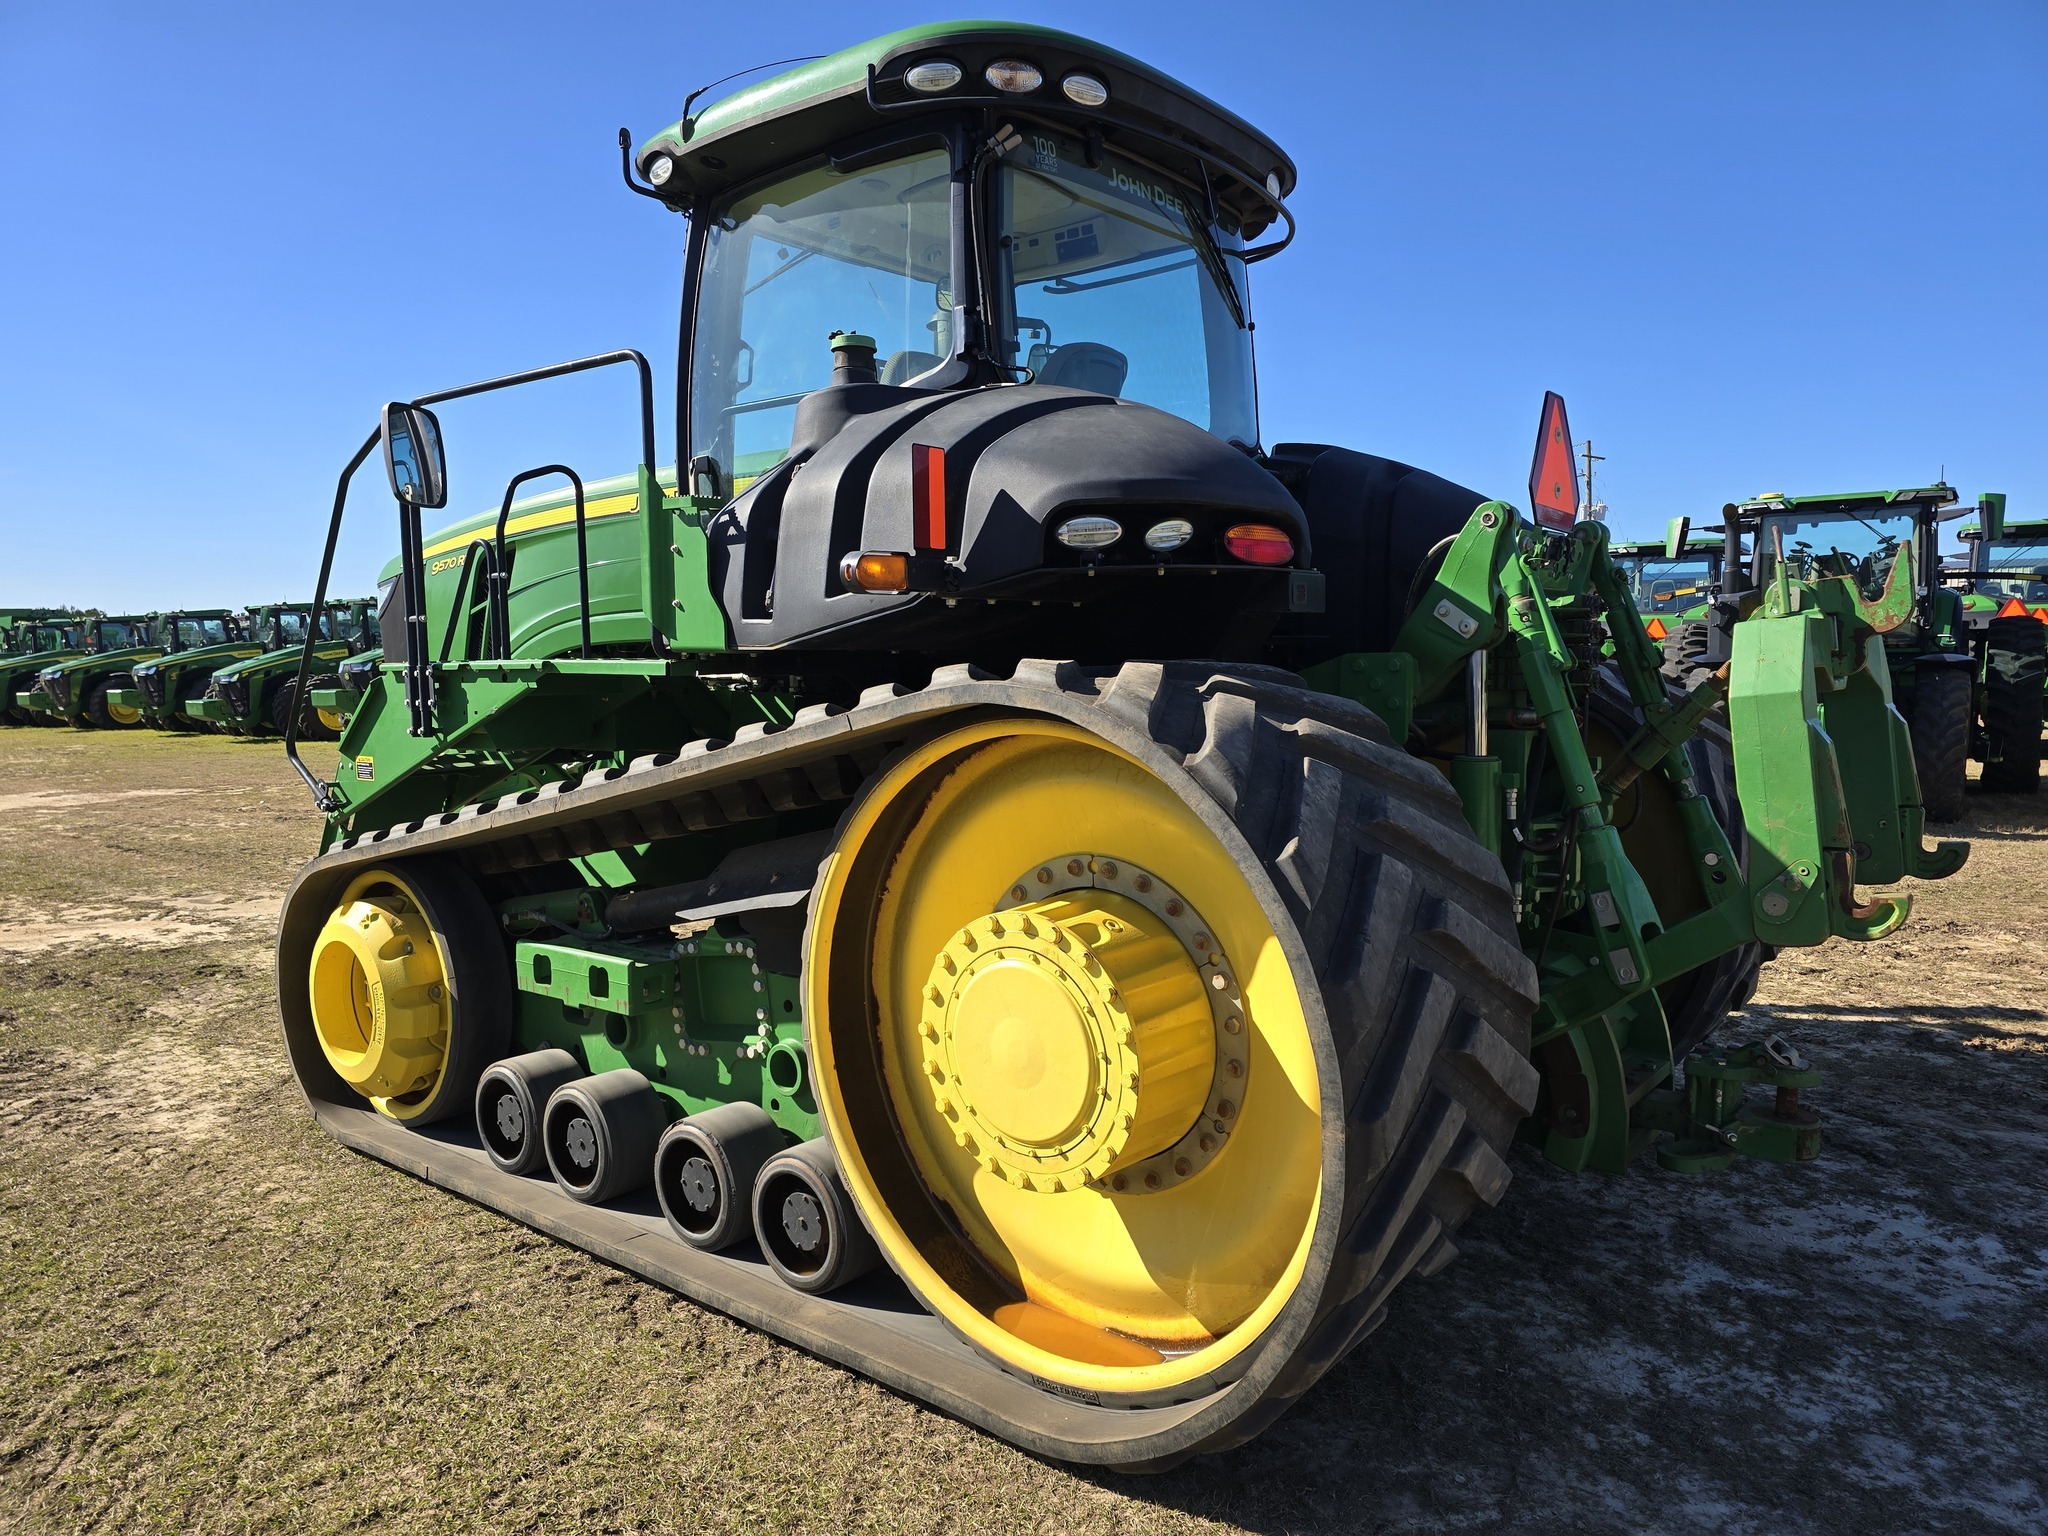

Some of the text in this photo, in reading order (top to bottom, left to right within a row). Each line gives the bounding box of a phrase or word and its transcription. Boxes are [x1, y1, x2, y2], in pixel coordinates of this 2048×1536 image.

[1033, 135, 1056, 158] 100
[1035, 153, 1058, 167] YEARS
[1108, 167, 1193, 219] JOHN DEE
